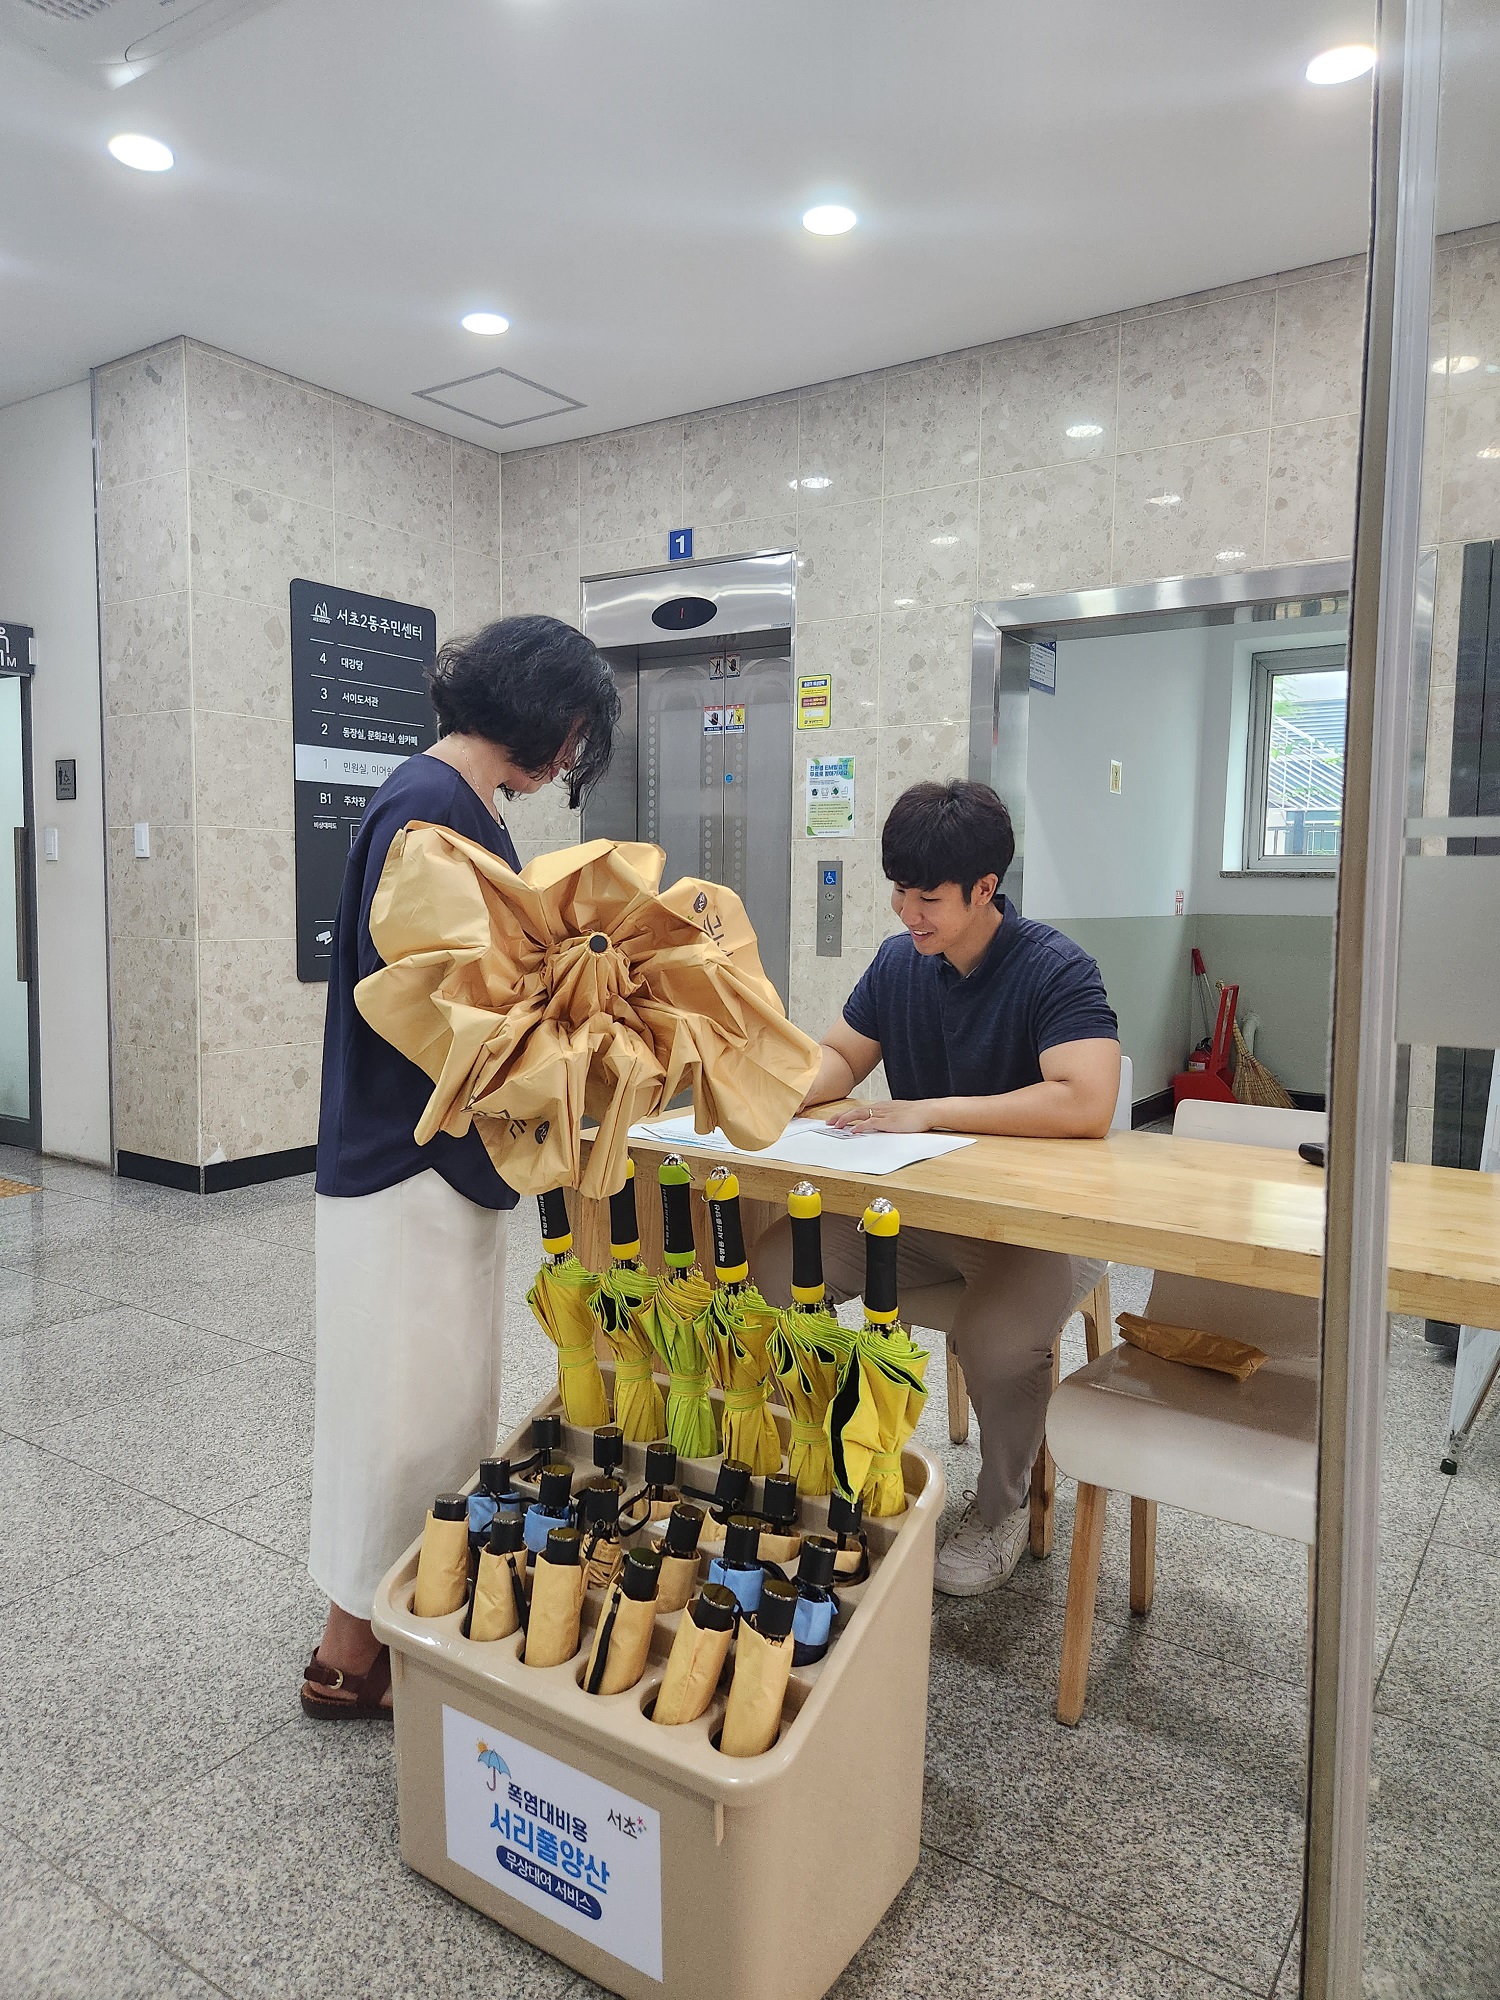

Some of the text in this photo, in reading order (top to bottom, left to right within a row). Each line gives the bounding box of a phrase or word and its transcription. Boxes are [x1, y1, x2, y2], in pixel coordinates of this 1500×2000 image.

[675, 535, 685, 554] 1
[337, 609, 423, 641] 서초2동주민센터
[6, 656, 17, 667] M
[319, 652, 364, 671] 4 대강당
[320, 687, 379, 708] 3 서이도서관
[320, 722, 328, 735] 2
[323, 758, 328, 770] 1
[319, 793, 366, 807] B1 주차장
[508, 1782, 588, 1842] 폭염대비용
[607, 1808, 638, 1840] 서초
[490, 1802, 610, 1895] 서리풀양산
[505, 1851, 593, 1913] 무상대여 서비스
